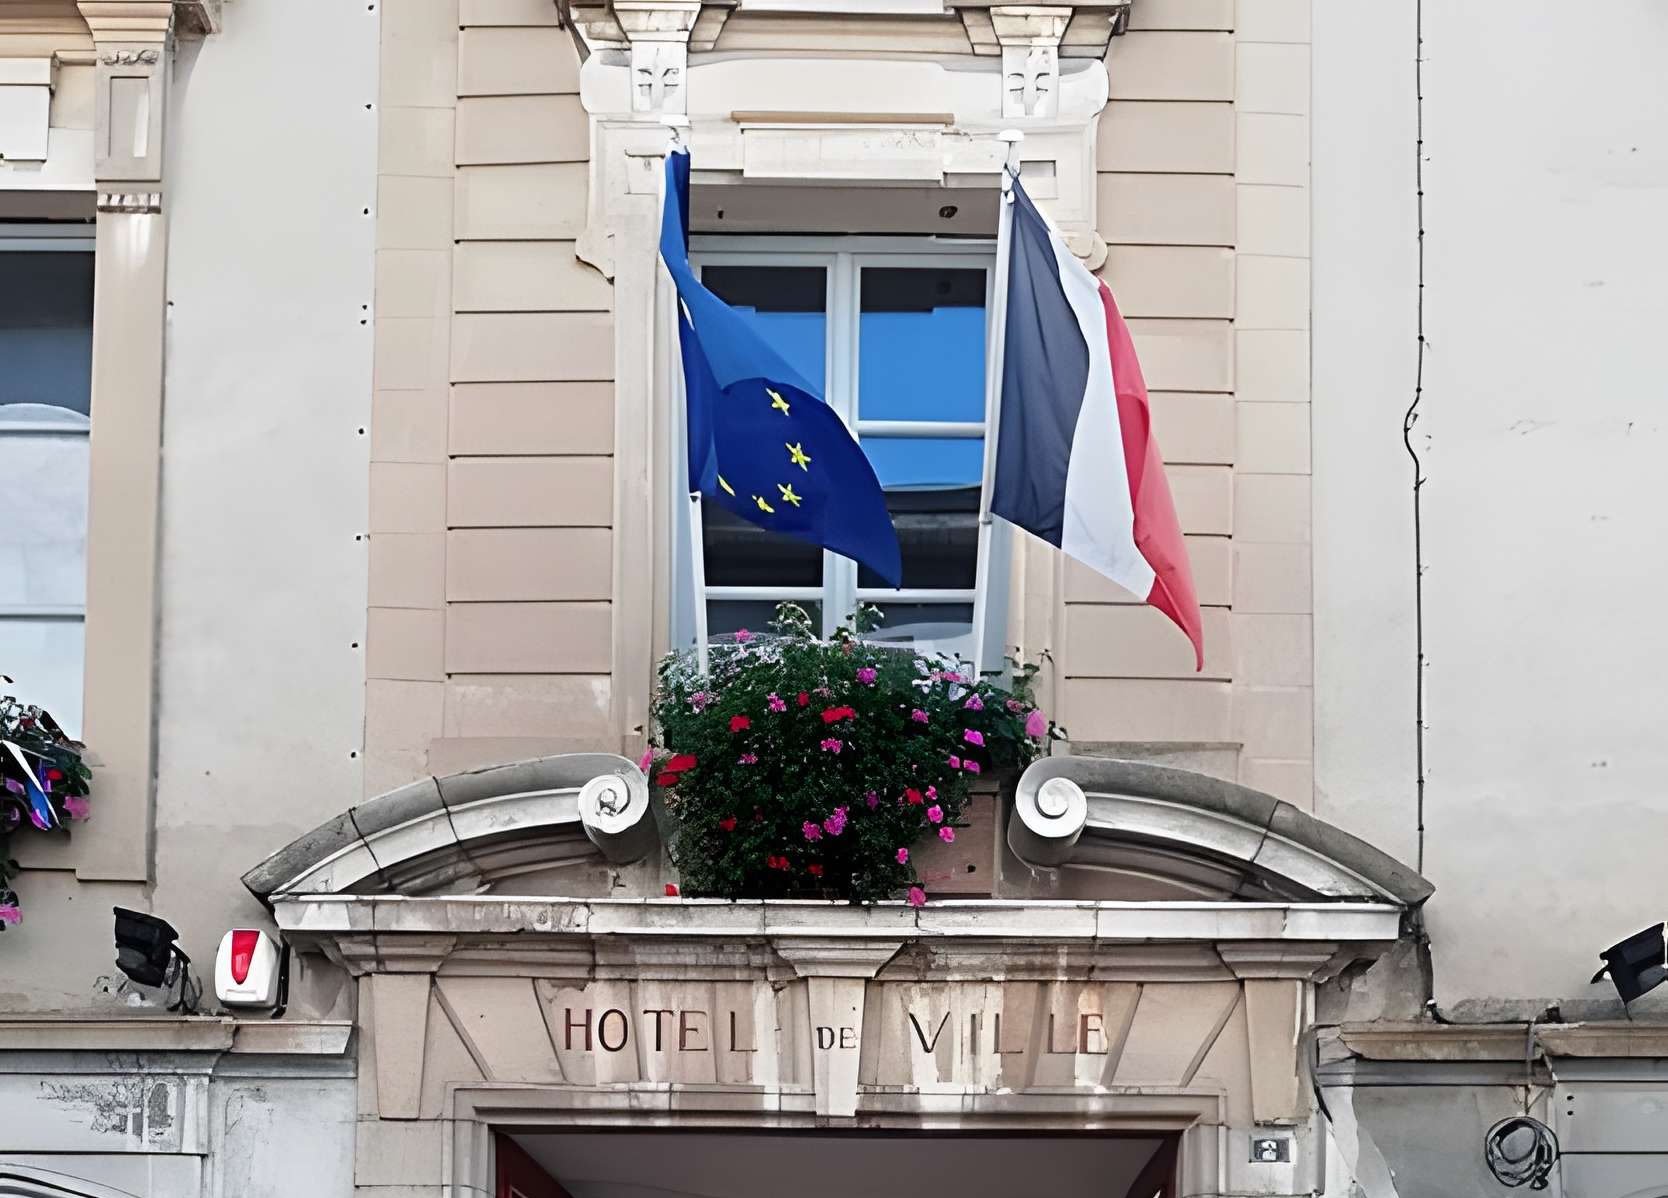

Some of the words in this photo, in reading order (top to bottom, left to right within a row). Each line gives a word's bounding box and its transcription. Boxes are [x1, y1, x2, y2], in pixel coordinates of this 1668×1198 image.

[565, 1008, 758, 1052] HOTEL
[816, 1026, 857, 1049] DE
[908, 1010, 1108, 1054] VILLE
